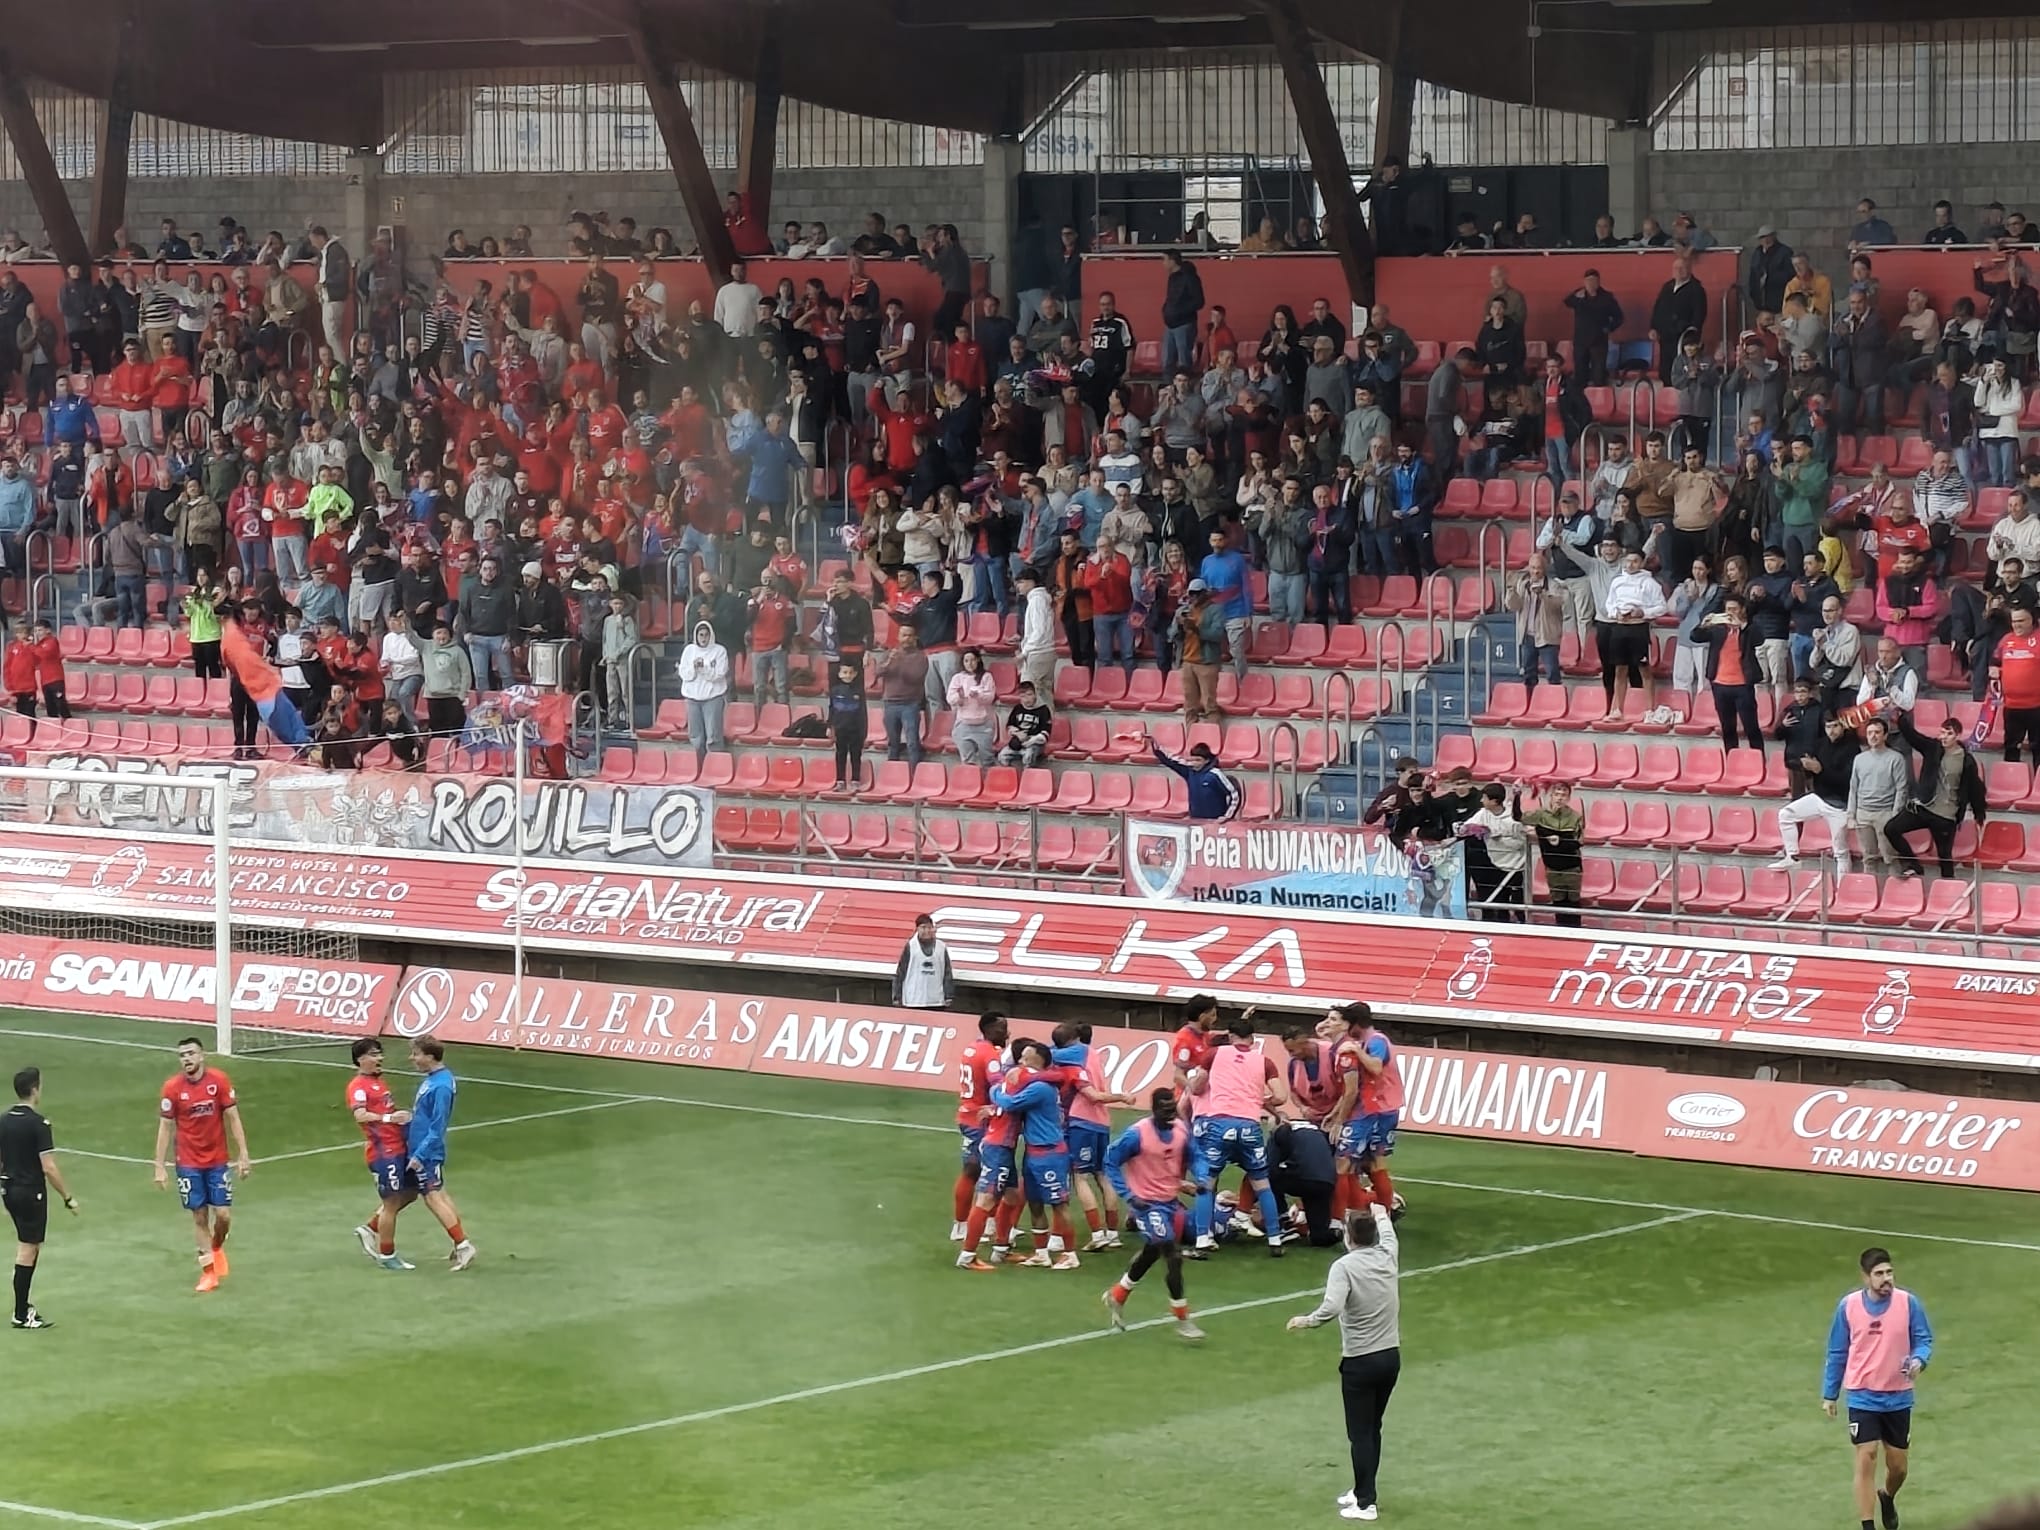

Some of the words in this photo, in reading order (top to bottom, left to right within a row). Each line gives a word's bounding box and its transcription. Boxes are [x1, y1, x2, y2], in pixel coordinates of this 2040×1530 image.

[1190, 826, 1242, 869] Peña
[1246, 829, 1368, 876] NUMANCIA
[156, 866, 217, 889] SAN
[229, 870, 409, 902] FRANCISCO
[618, 922, 635, 937] Y
[638, 923, 744, 945] CALIDAD
[931, 906, 1307, 988] ELKA
[44, 952, 217, 1005] SCANIA
[1584, 942, 1798, 982] FRUTAS
[295, 968, 384, 999] BODY
[1953, 974, 2039, 996] PATATAS
[284, 994, 374, 1021] TRUCK
[462, 981, 764, 1044] SILLERAS
[1679, 1100, 1736, 1117] Carrier
[1793, 1090, 2022, 1152] Carrier
[1809, 1146, 1979, 1179] TRANSICOLD
